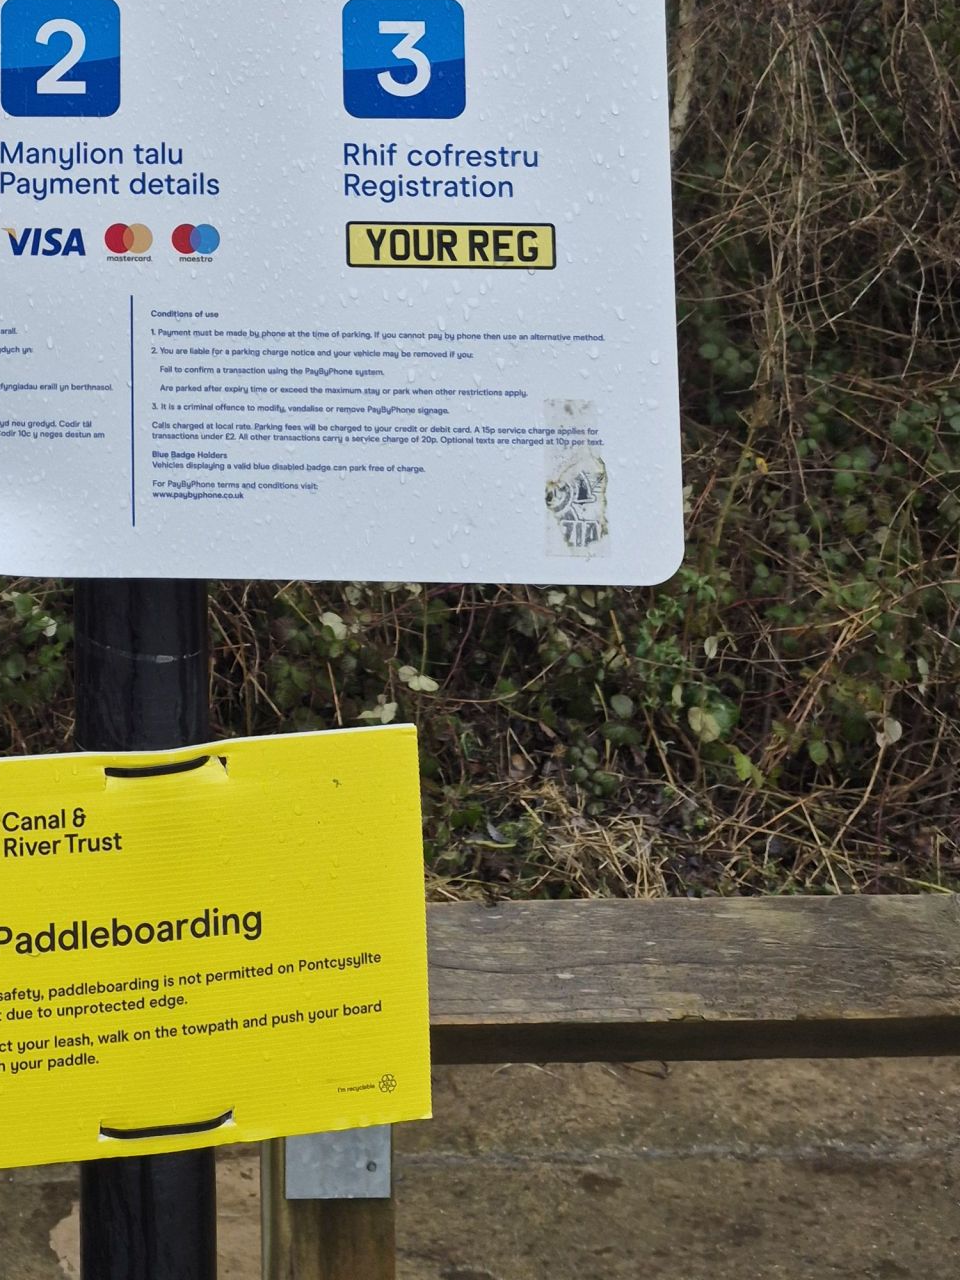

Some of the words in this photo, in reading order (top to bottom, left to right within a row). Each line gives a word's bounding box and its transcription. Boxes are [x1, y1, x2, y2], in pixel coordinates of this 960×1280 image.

[36, 19, 86, 93] 2
[378, 21, 430, 96] 3
[1, 142, 122, 170] Manylion
[134, 142, 182, 164] talu
[344, 143, 397, 165] Rhif
[408, 144, 537, 167] cofrestru
[1, 172, 119, 200] Payment
[130, 172, 219, 195] details
[345, 174, 513, 203] Registration
[2, 227, 86, 256] VISA
[365, 228, 458, 261] YOUR
[469, 229, 540, 263] REG
[150, 309, 193, 317] Conditions
[194, 309, 204, 318] of
[152, 451, 169, 459] Blue
[170, 451, 196, 460] Badge
[197, 451, 228, 459] Holders
[152, 490, 244, 500] www.paybyphone.co.uk
[3, 809, 65, 831] Canal
[73, 808, 86, 827] &
[4, 837, 61, 857] River
[65, 833, 122, 853] Trust
[49, 978, 159, 1000] paddleboarding
[164, 978, 174, 987] is
[179, 973, 201, 985] not
[206, 964, 272, 985] permitted
[278, 964, 293, 974] on
[299, 953, 381, 971] Pontcysyllte
[7, 1008, 32, 1020] due
[38, 1007, 52, 1018] to
[57, 997, 144, 1018] unprotected
[150, 995, 188, 1009] edge.
[18, 1040, 49, 1054] your
[55, 1034, 93, 1047] leash,
[98, 1030, 128, 1043] walk
[134, 1031, 150, 1040] on
[155, 1026, 177, 1038] the
[182, 1018, 238, 1035] towpath
[243, 1014, 267, 1028] and
[272, 1010, 303, 1027] push
[309, 1009, 338, 1023] your
[343, 1001, 381, 1015] board
[11, 1060, 42, 1074] your
[48, 1053, 100, 1071] paddle.
